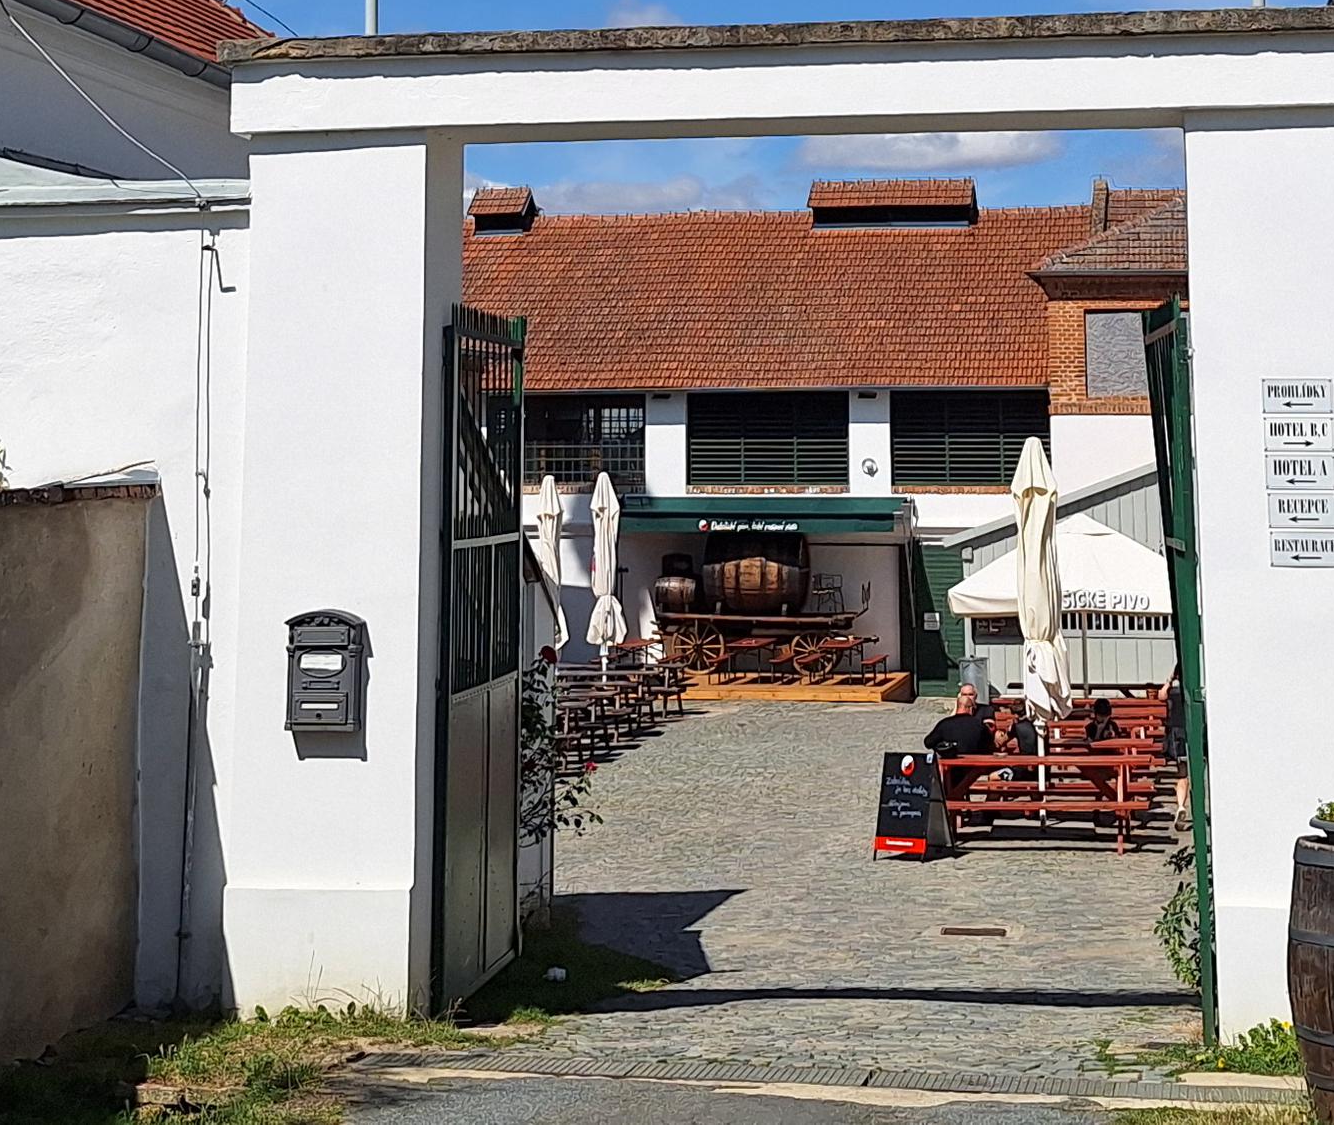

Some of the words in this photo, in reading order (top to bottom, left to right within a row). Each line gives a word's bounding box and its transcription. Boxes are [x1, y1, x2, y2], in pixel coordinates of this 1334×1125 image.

[1267, 382, 1327, 398] PROHLÁDKY
[1269, 422, 1308, 437] HOTEL
[1273, 460, 1317, 476] HOTEL
[1320, 460, 1328, 476] A
[1278, 499, 1329, 514] RECEPCE
[1111, 591, 1151, 610] PIVO
